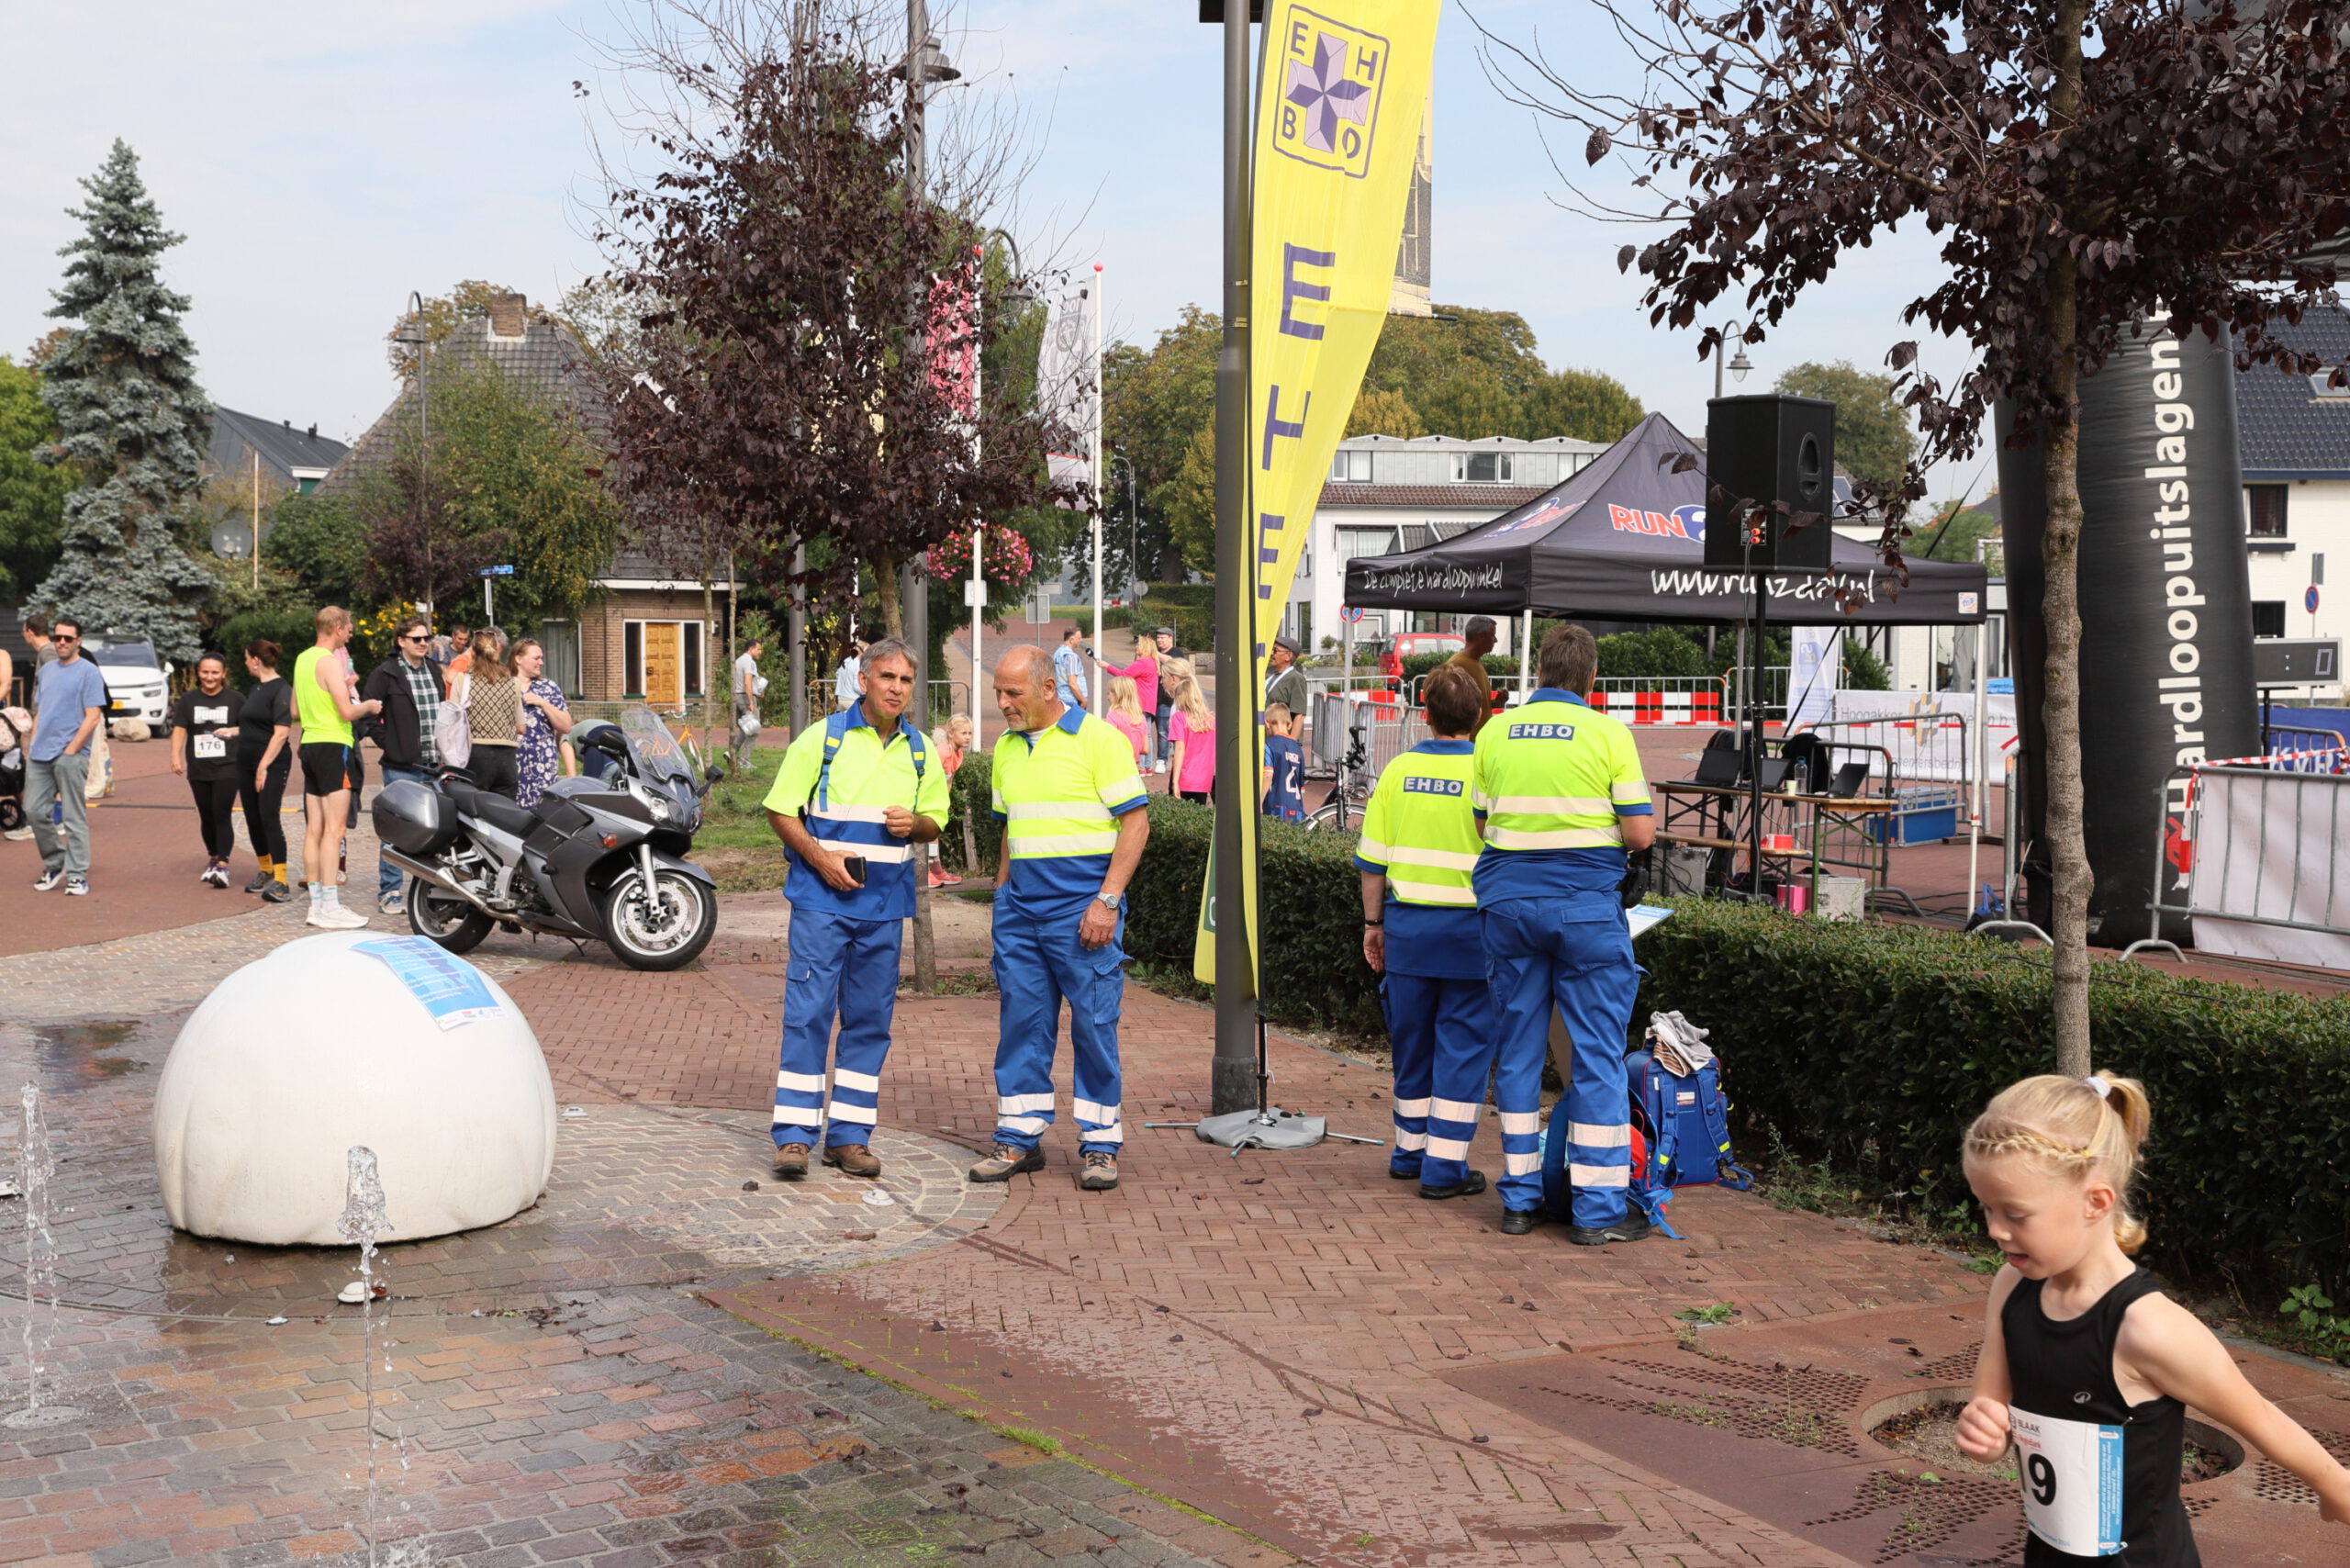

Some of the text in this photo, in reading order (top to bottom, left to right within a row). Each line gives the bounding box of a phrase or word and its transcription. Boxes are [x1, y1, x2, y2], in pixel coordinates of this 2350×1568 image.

[1363, 569, 1378, 590] De
[1425, 561, 1503, 599] hardloopwinkel
[1509, 724, 1573, 738] EHBO
[199, 741, 222, 750] 176
[1285, 767, 1302, 801] 4
[1404, 778, 1462, 794] EHBO
